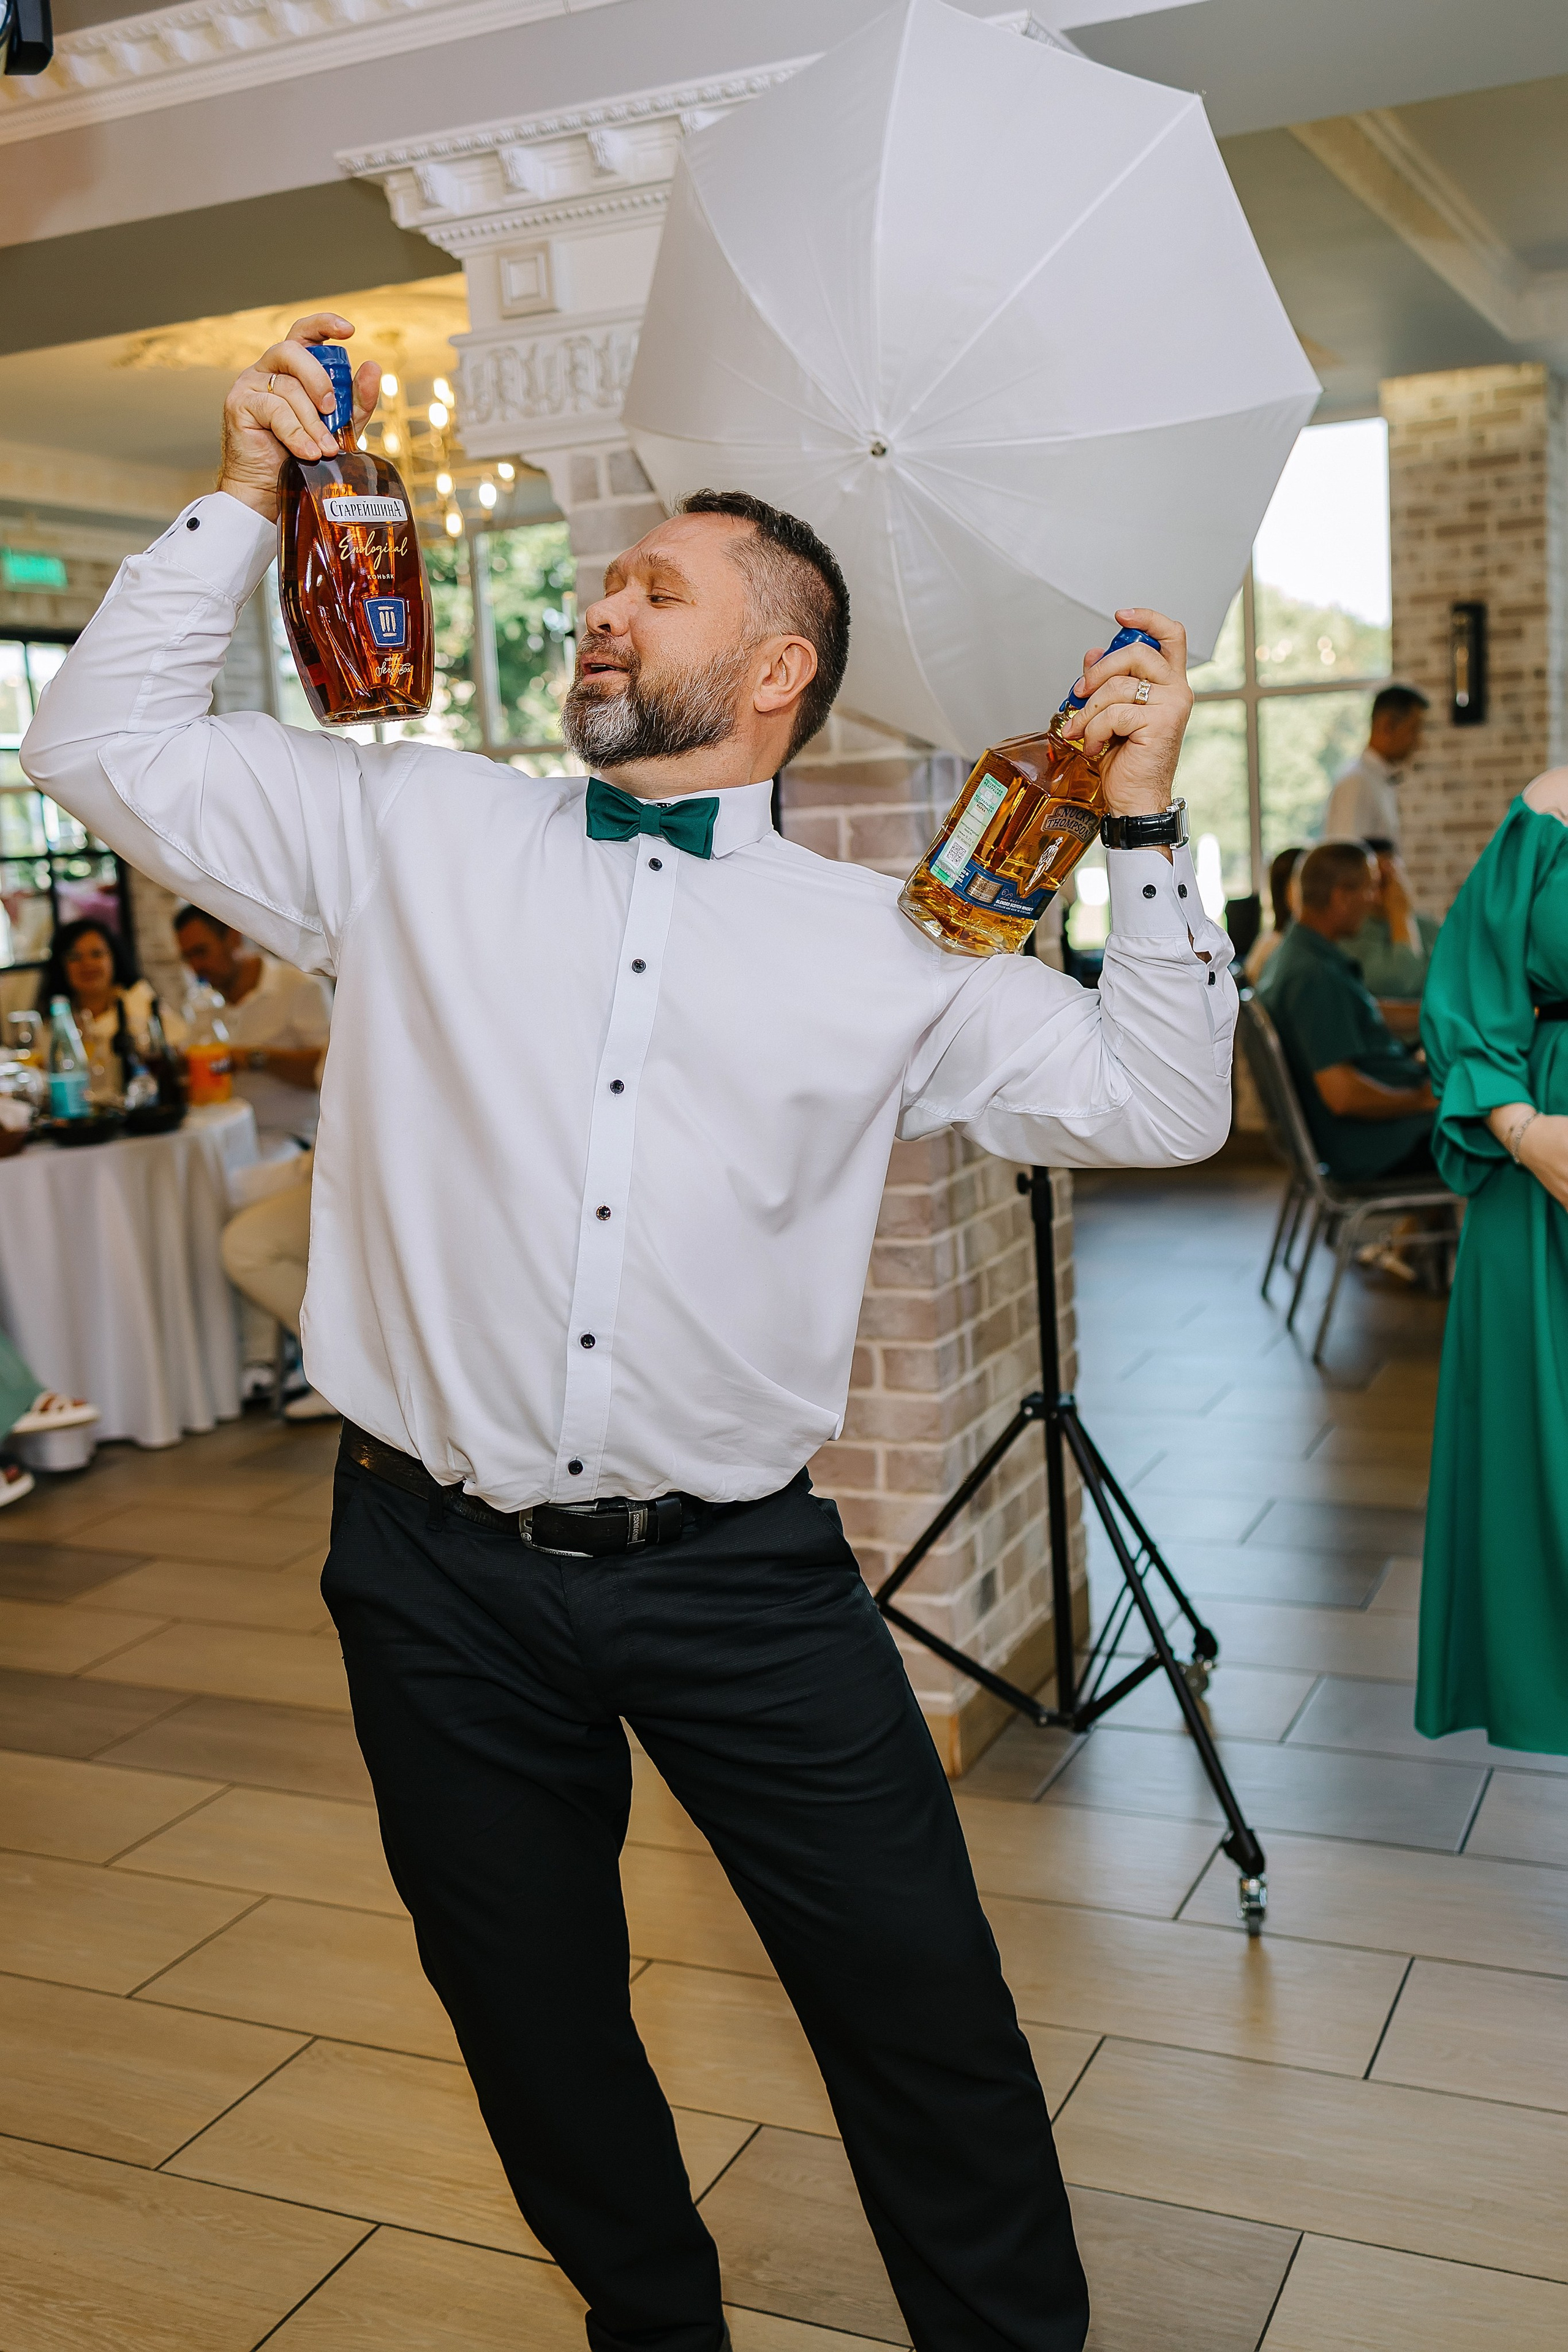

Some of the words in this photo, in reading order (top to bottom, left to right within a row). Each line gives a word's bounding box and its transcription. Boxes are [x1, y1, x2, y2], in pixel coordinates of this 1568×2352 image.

[330, 500, 402, 517] СТАРЕЙШИНА
[339, 530, 408, 570] Enological
[1060, 808, 1094, 825] NUCKY
[1047, 818, 1091, 839] THOMPSON
